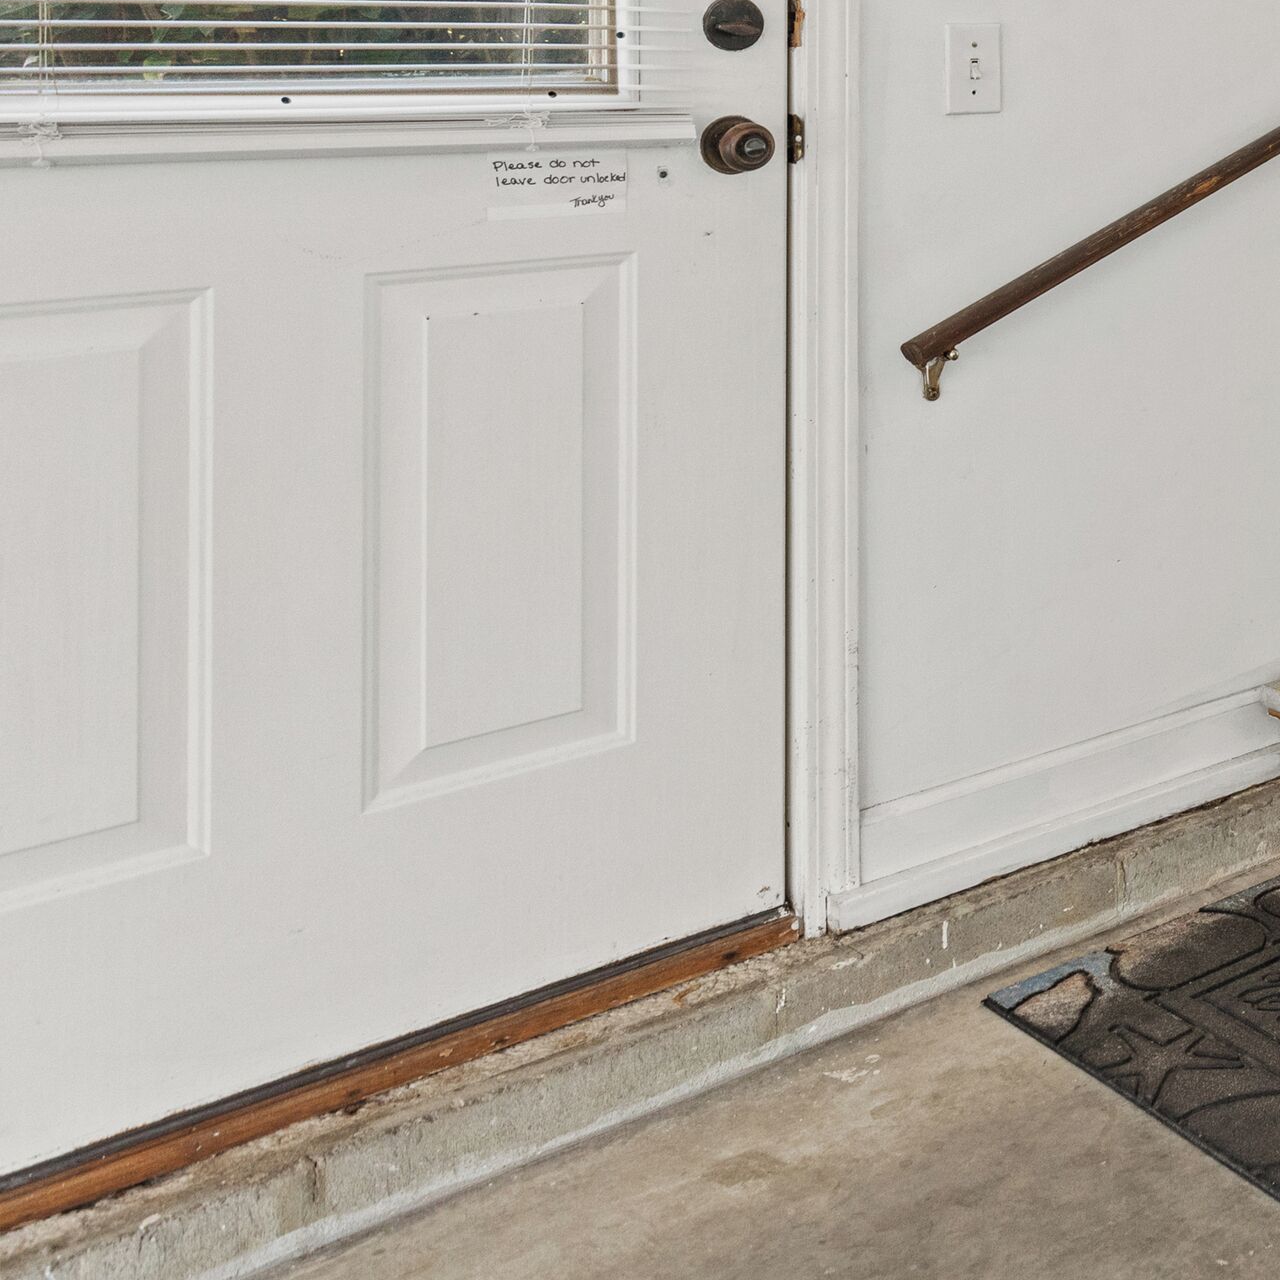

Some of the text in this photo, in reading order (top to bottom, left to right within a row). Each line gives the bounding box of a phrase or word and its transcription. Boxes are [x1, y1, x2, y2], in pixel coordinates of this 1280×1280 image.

[492, 158, 600, 171] Please do not
[495, 172, 626, 187] leave door unlocked
